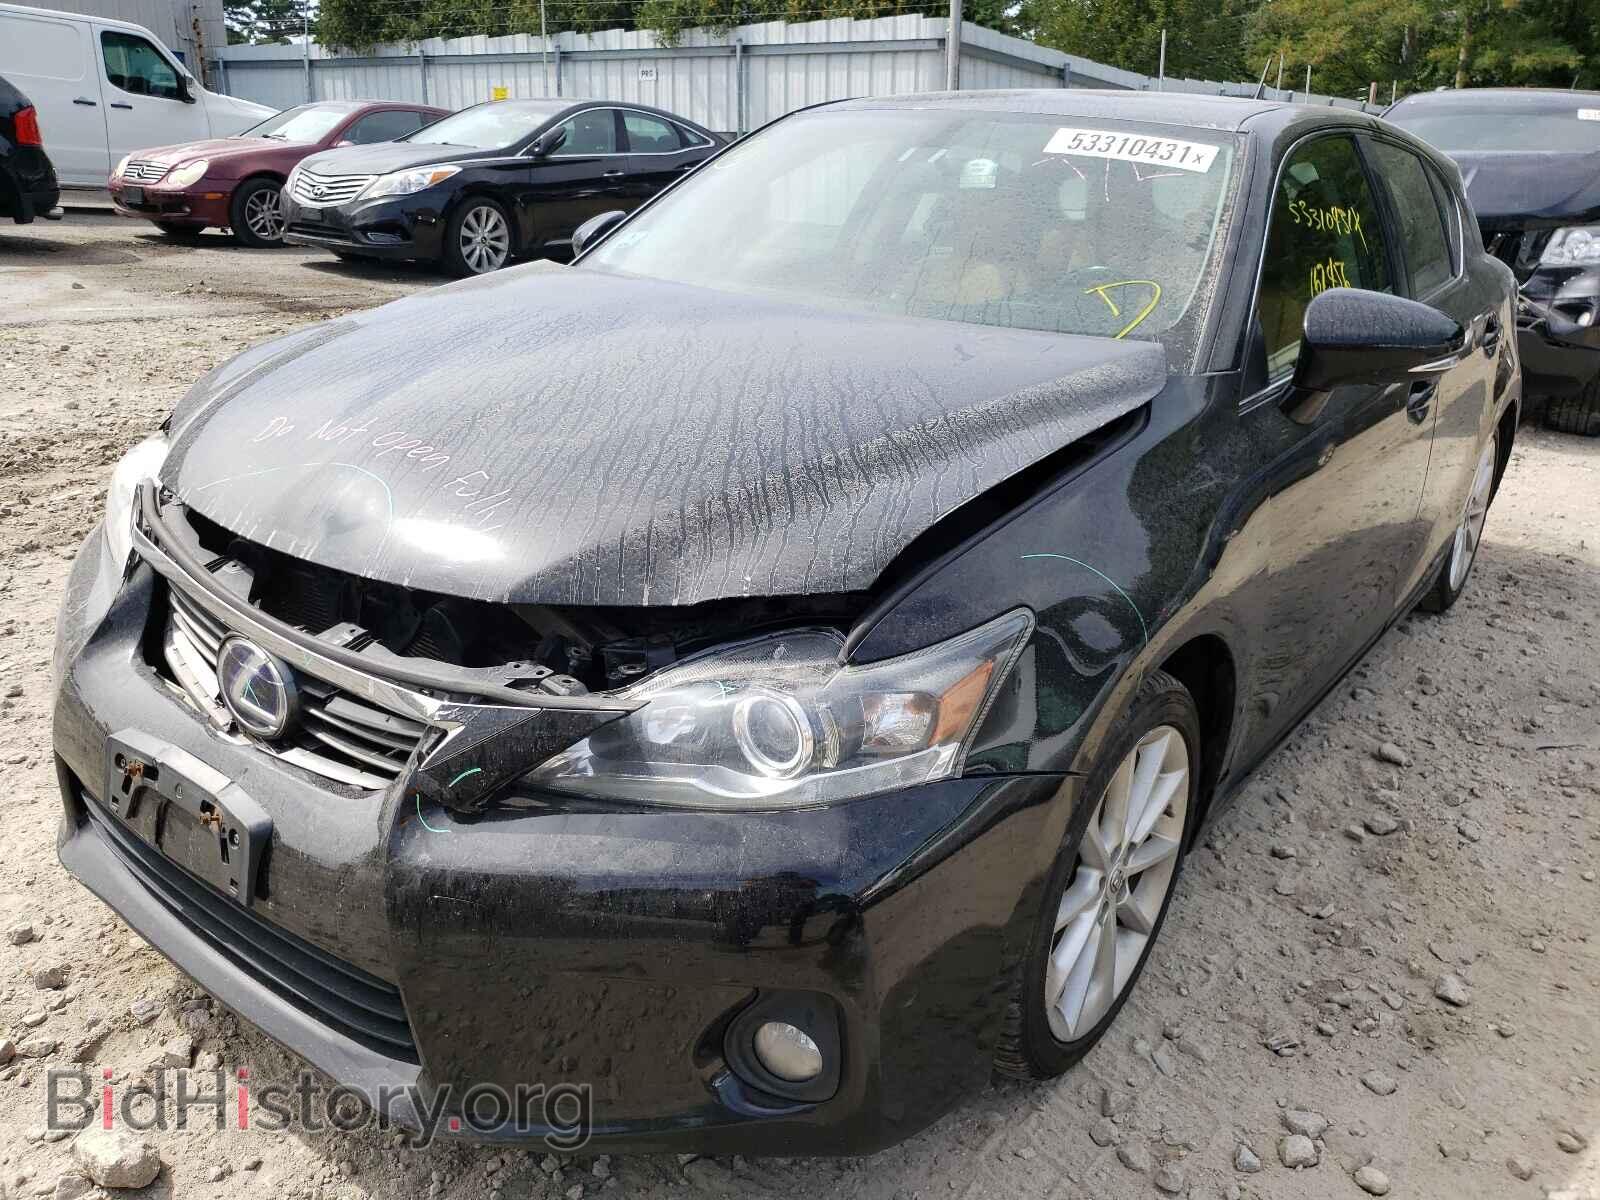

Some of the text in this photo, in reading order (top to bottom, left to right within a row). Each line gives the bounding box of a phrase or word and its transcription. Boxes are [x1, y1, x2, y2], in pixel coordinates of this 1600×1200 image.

[1084, 280, 1161, 339] D
[253, 416, 295, 443] Do
[308, 416, 379, 445] Not
